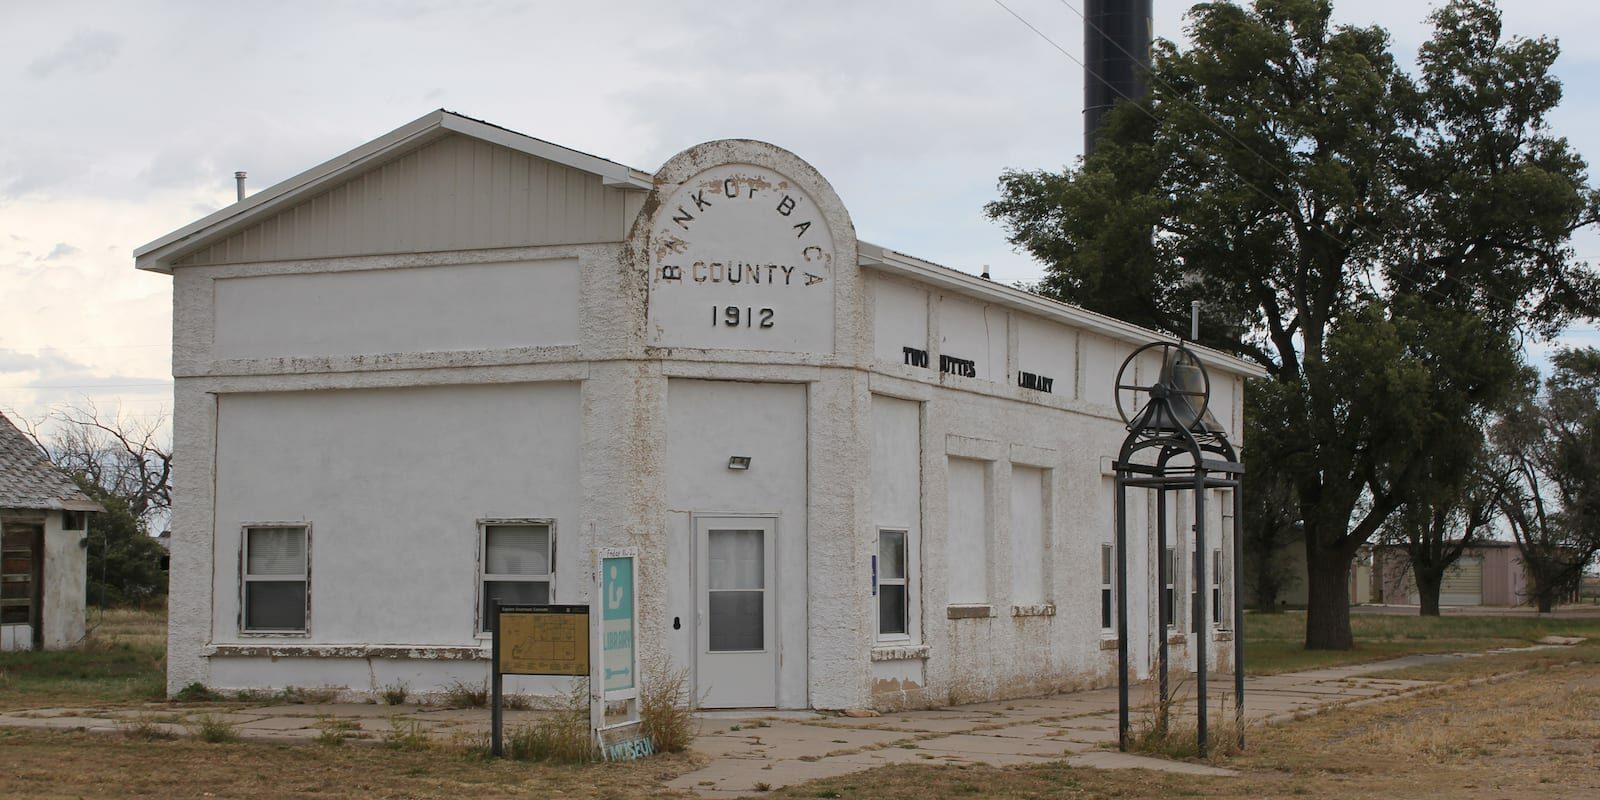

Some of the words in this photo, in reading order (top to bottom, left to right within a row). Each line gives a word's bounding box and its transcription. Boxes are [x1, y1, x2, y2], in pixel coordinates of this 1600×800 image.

[776, 195, 824, 286] BACA
[692, 261, 795, 285] COUNTY
[711, 305, 775, 329] 1912
[903, 346, 929, 369] TWO
[603, 630, 632, 651] LIBRARY
